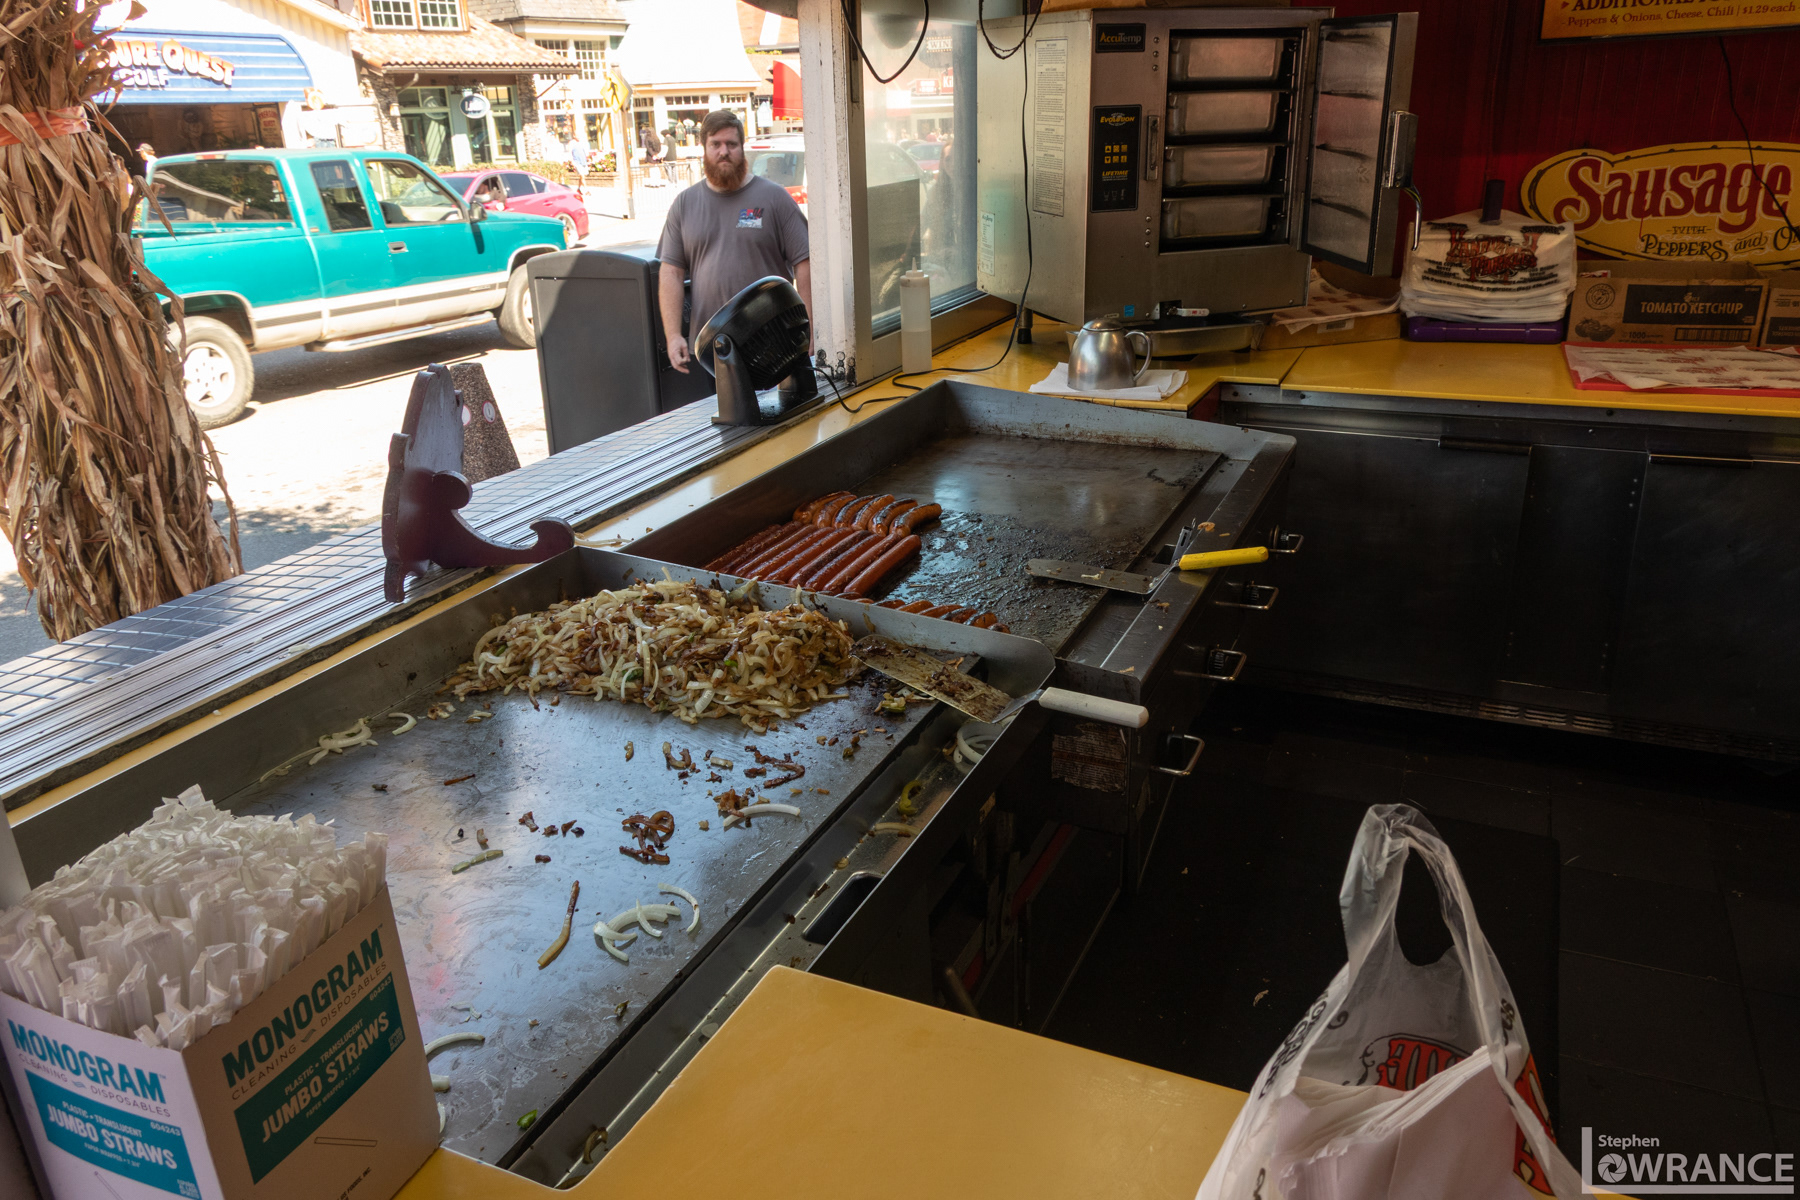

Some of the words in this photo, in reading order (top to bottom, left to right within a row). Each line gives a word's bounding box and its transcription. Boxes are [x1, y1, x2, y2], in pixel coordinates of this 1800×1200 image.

[1568, 16, 1607, 28] Peppers
[1610, 13, 1620, 25] &
[1622, 12, 1663, 22] Onions,
[1707, 6, 1734, 17] Chili
[1742, 4, 1769, 15] $1.29
[1770, 1, 1796, 13] each
[1571, 0, 1694, 11] ADDITI
[929, 40, 953, 48] WIN
[1099, 31, 1142, 44] AccuTemp
[118, 68, 168, 86] GOLF
[162, 38, 235, 86] QUEST
[1102, 169, 1129, 177] LIFETIME
[1552, 157, 1793, 234] Sausage
[1672, 225, 1707, 235] WITH
[1641, 233, 1729, 262] PEPPERS
[1734, 232, 1768, 252] and
[1640, 301, 1687, 314] TOMATO
[1689, 302, 1744, 315] KETCHUP
[1629, 331, 1646, 339] 1000
[369, 976, 392, 1001] 604243
[222, 929, 383, 1088] MONOGRAM
[231, 1044, 296, 1101] CLEANING
[320, 961, 387, 1027] DISPOSABLES
[7, 1018, 166, 1104] MONOGRAM
[284, 1065, 315, 1096] PLASTIC
[319, 1019, 363, 1065] TRANSLUCENT
[18, 1053, 68, 1083] CLEANING
[90, 1085, 171, 1118] DISPOSABLES
[262, 1075, 322, 1143] JUMBO
[325, 1011, 389, 1083] STRAWS
[305, 1101, 322, 1118] PAPER
[322, 1080, 345, 1103] WRAPPED
[62, 1100, 88, 1119] PLASTIC
[94, 1114, 143, 1138] TRANSLUCENT
[149, 1120, 182, 1137] 604243
[47, 1103, 99, 1143] JUMBO
[100, 1127, 178, 1170] STRAWS
